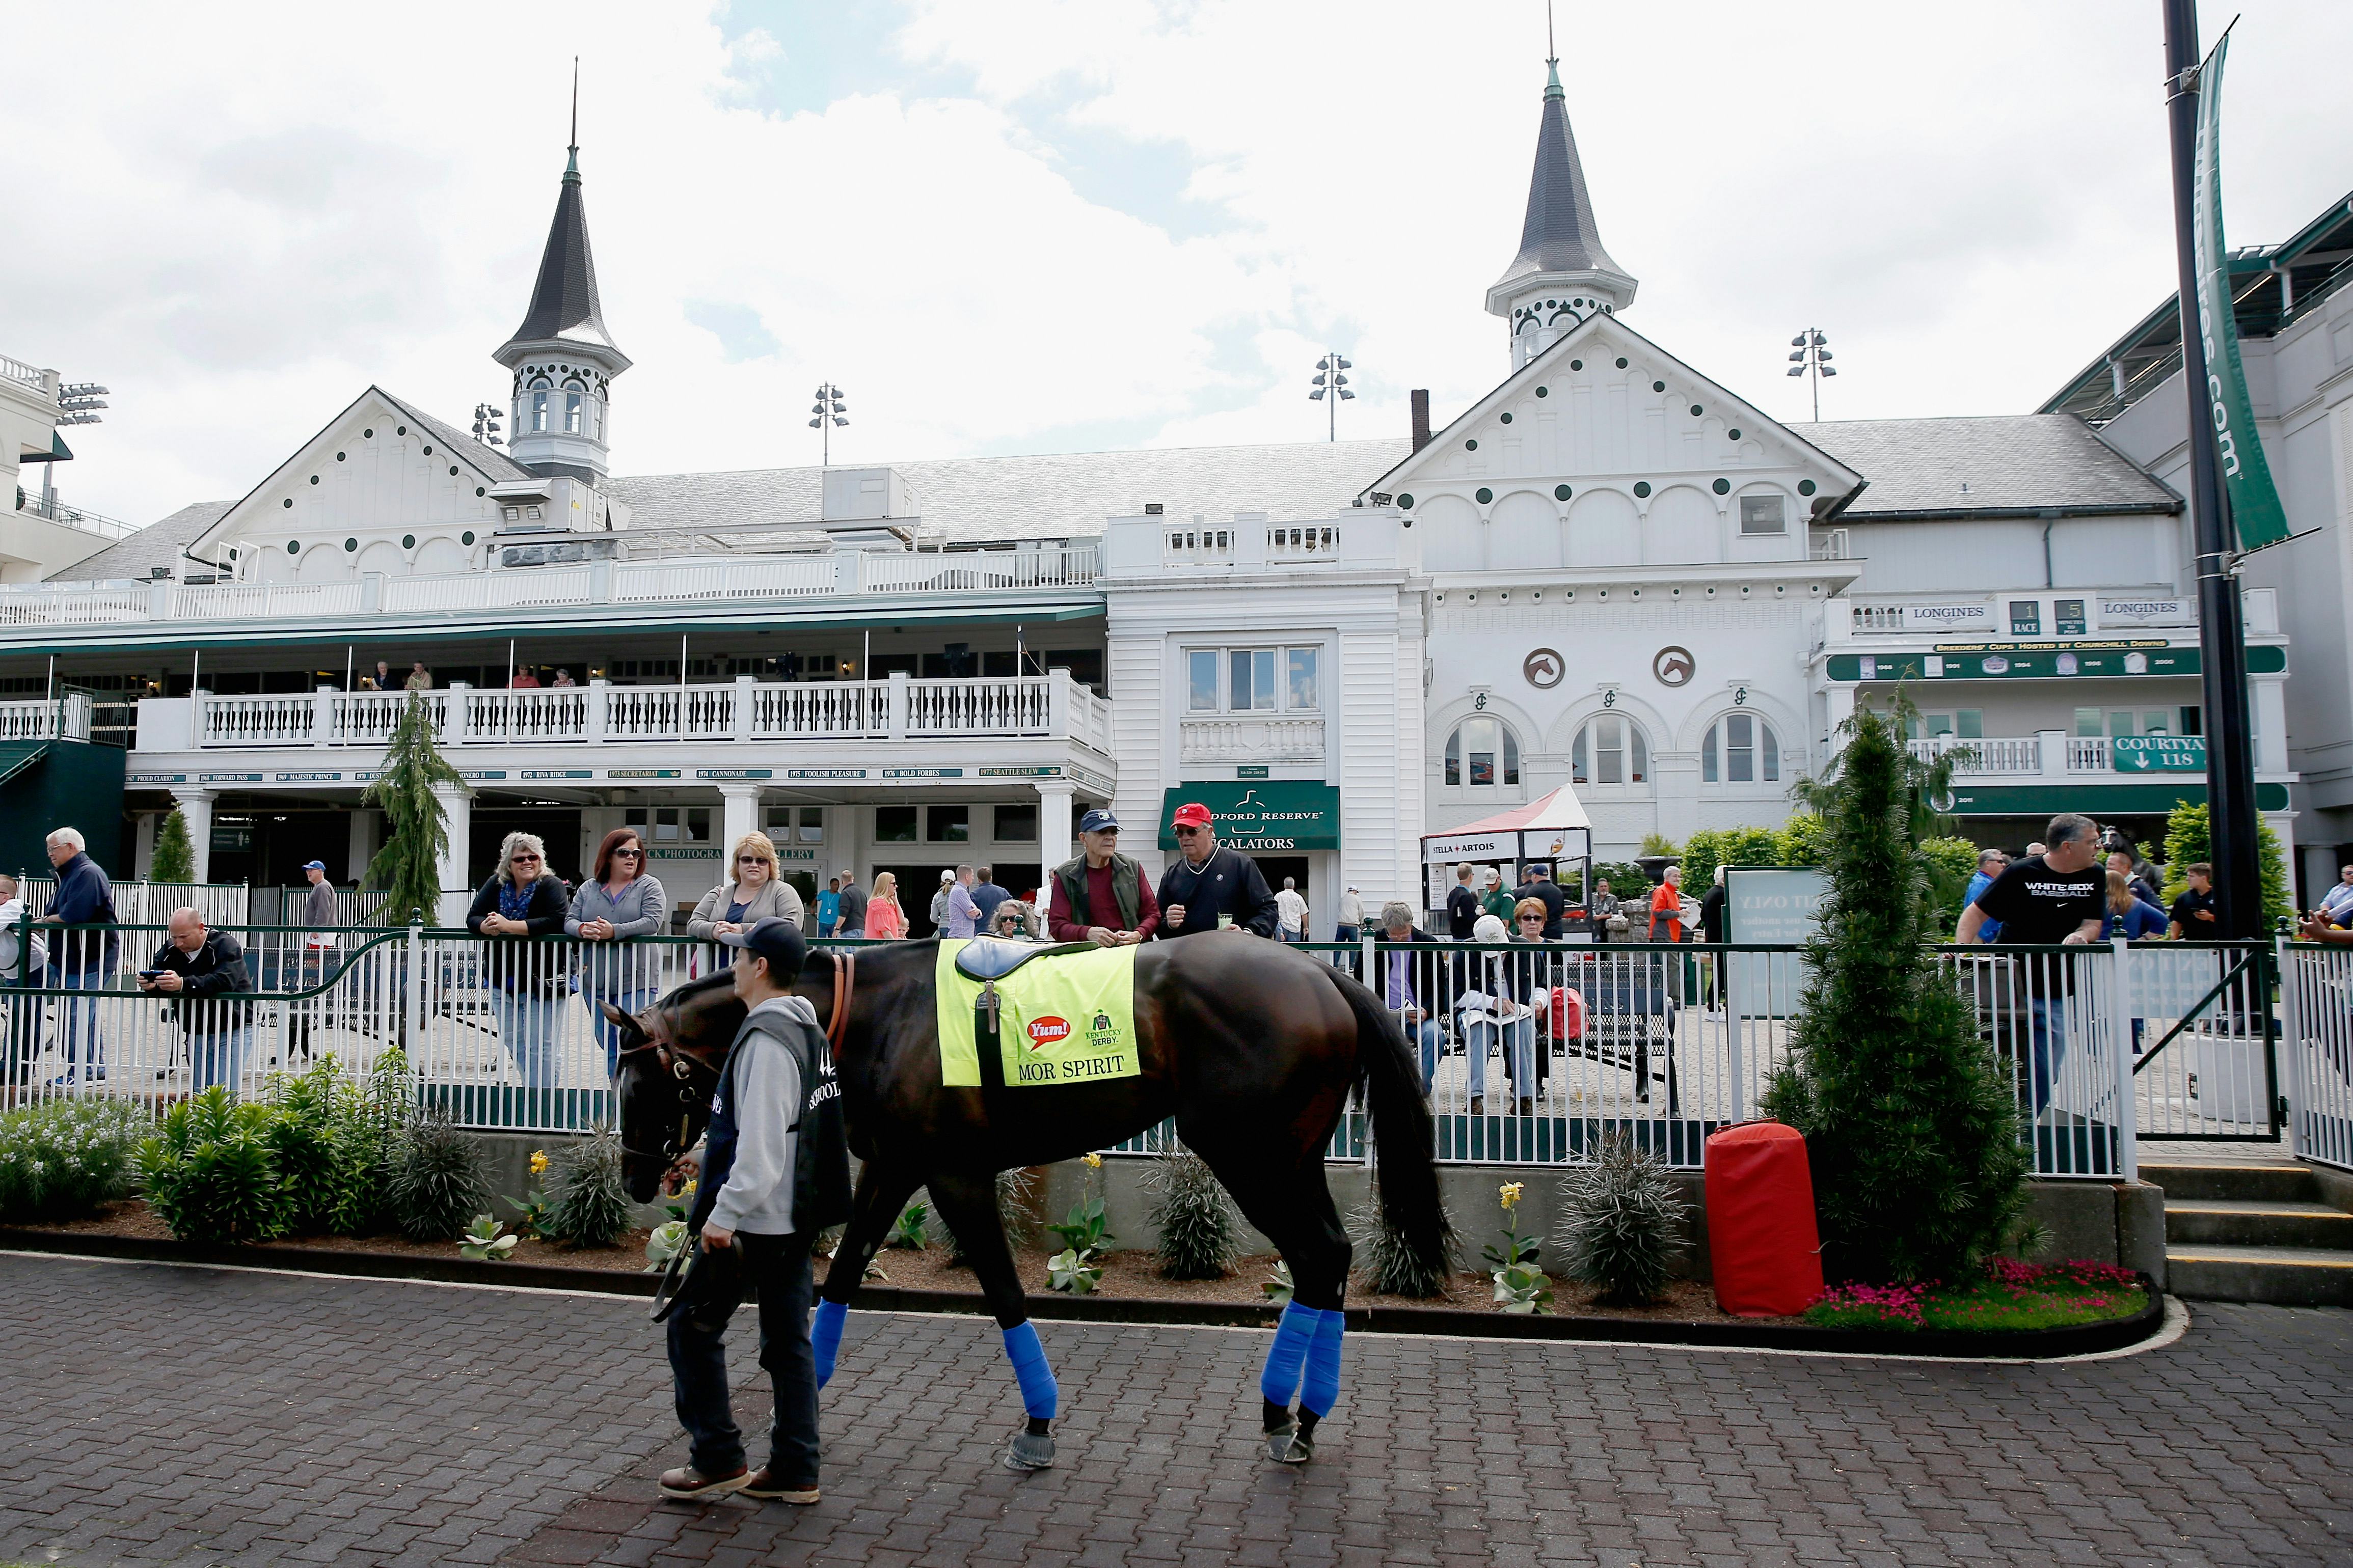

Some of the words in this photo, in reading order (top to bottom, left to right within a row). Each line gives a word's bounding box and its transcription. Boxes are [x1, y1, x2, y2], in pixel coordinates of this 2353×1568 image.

[1914, 607, 1984, 618] LONGINES
[2026, 605, 2034, 618] 1
[2069, 604, 2080, 617] 5
[2104, 602, 2177, 613] LONGINES
[2014, 623, 2038, 632] RACE
[2116, 737, 2205, 750] COURTYA
[2160, 753, 2194, 765] 118
[1261, 812, 1319, 820] RESERVE
[1214, 838, 1294, 849] CALATORS
[1462, 842, 1495, 852] ARTOIS
[665, 849, 721, 858] PHOTOGRA
[777, 850, 812, 859] LLERY
[2024, 882, 2067, 891] WHITE
[1031, 1021, 1068, 1037] Yum!
[1086, 1028, 1121, 1039] KENTUCKY
[1092, 1036, 1117, 1046] DERBY
[1019, 1063, 1056, 1081] MOR
[1063, 1055, 1125, 1078] SPIRIT
[809, 1081, 841, 1110] SCHOOL
